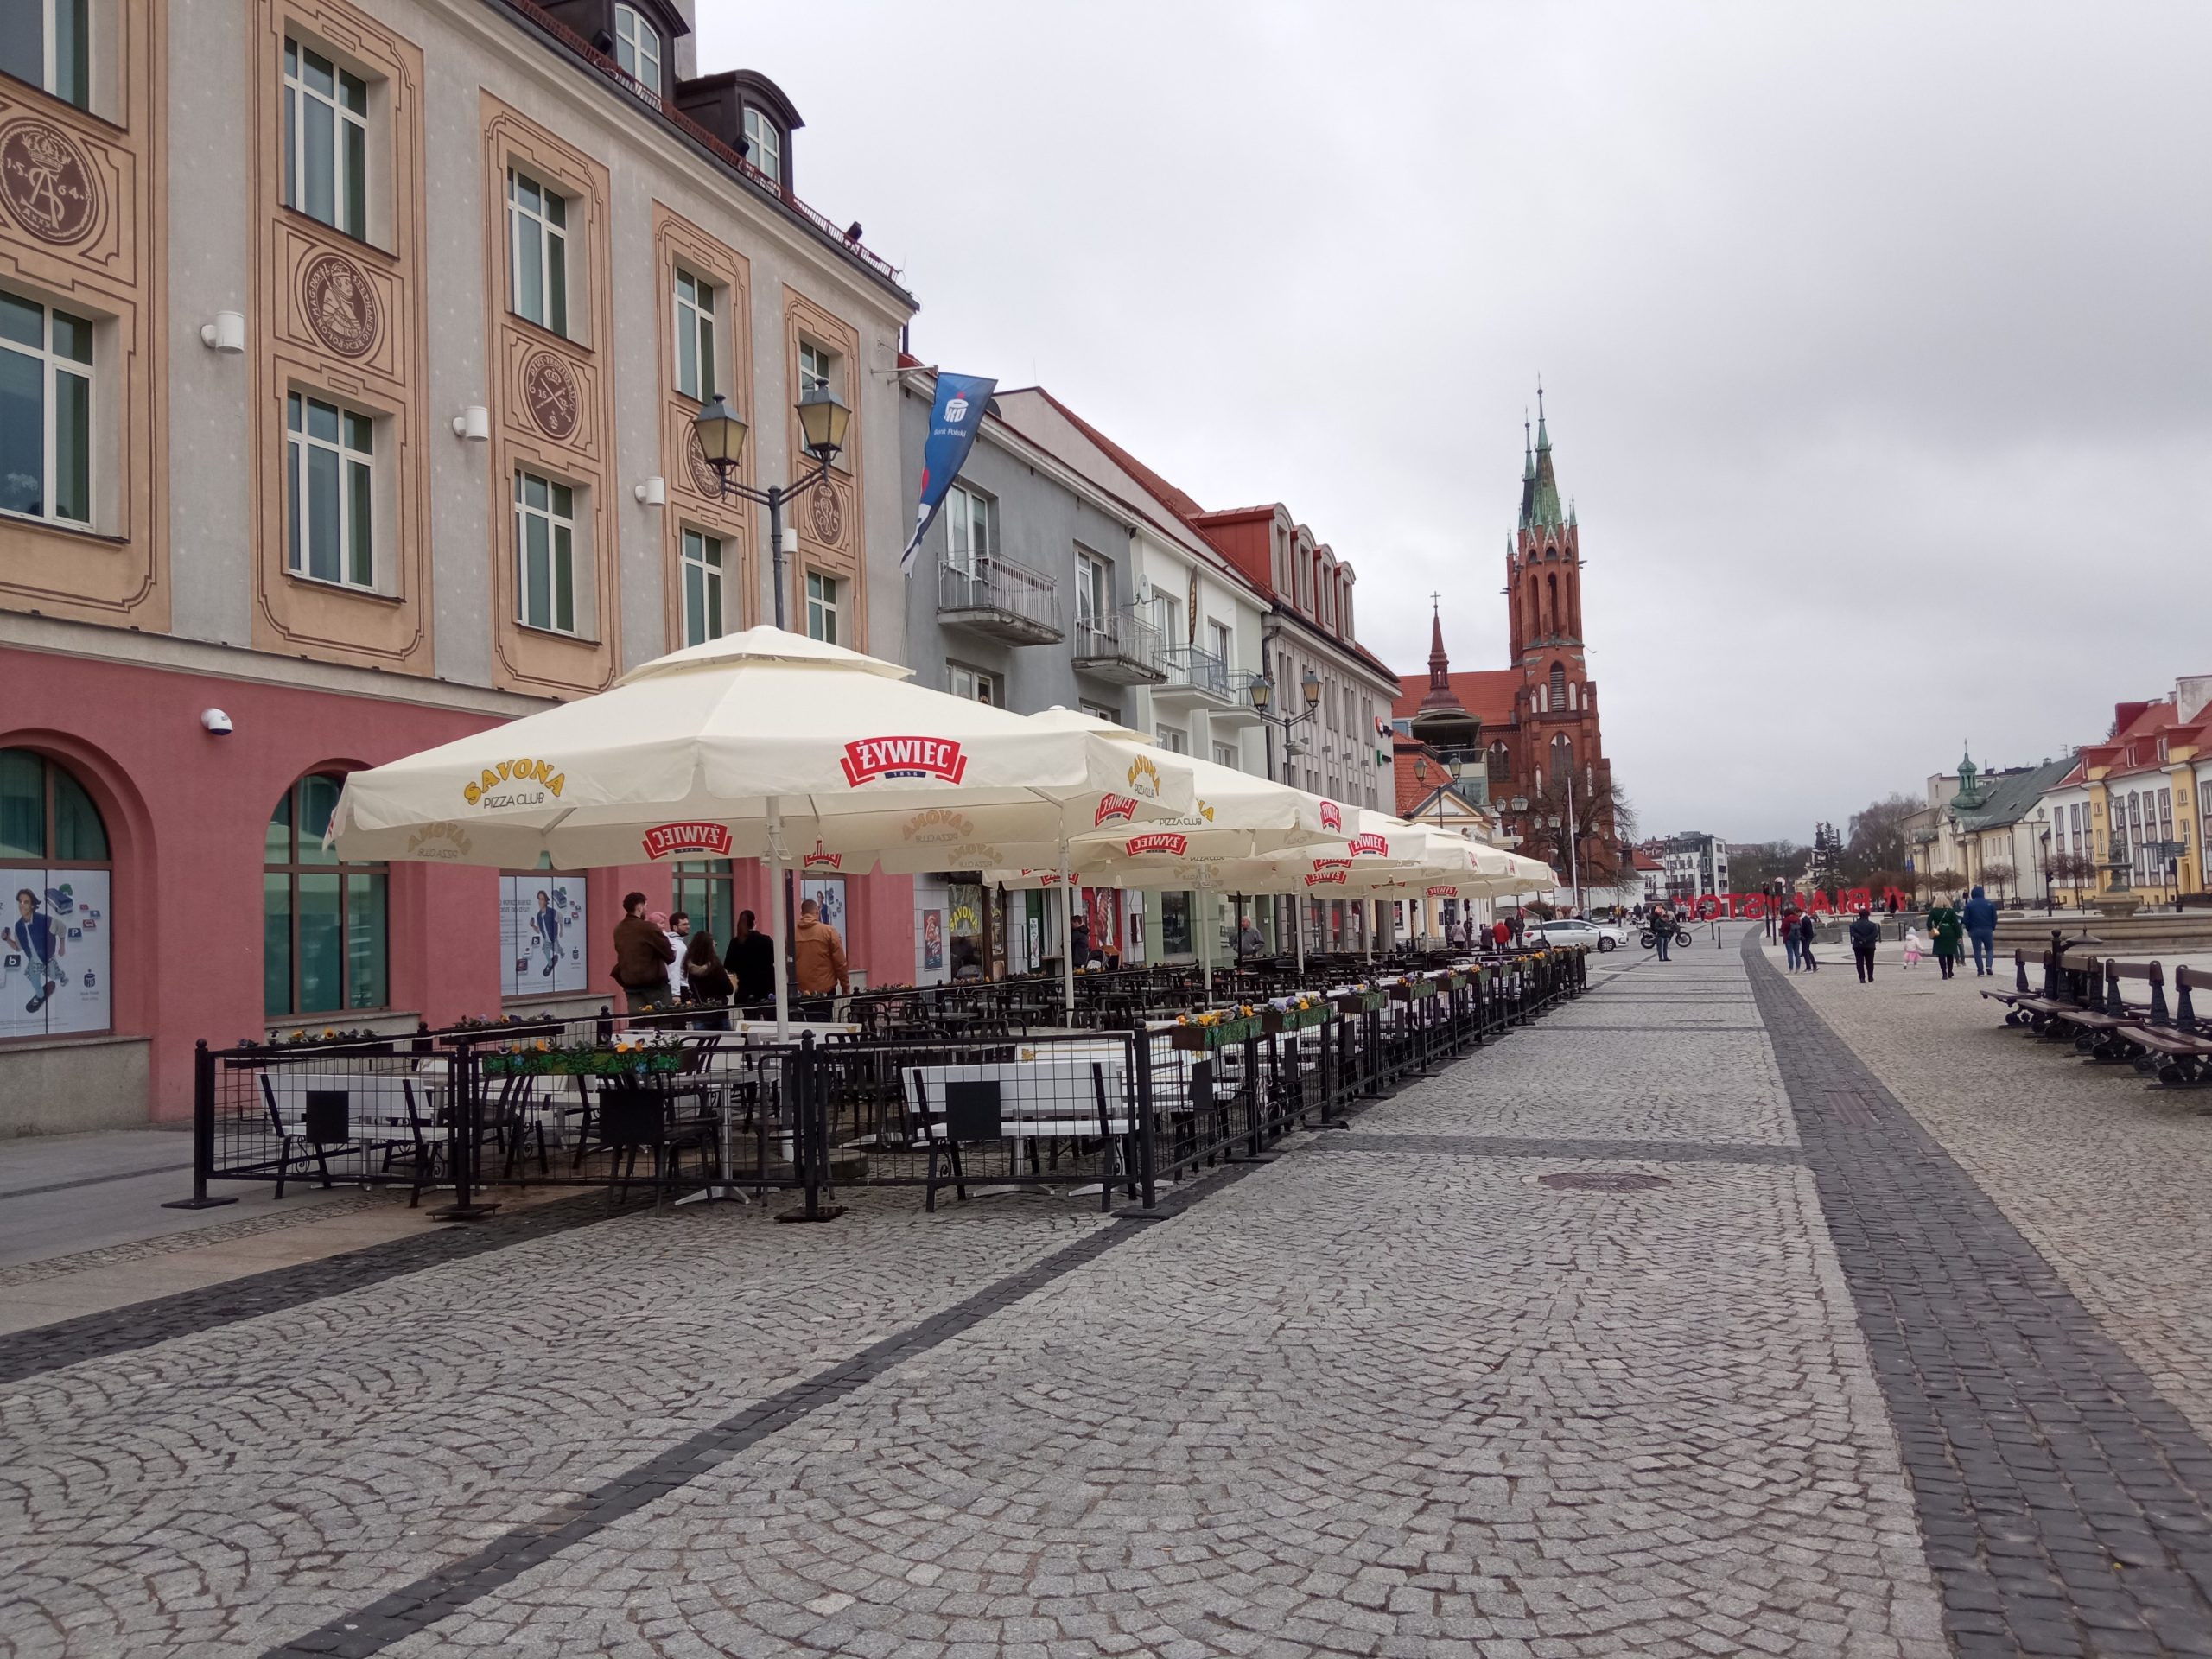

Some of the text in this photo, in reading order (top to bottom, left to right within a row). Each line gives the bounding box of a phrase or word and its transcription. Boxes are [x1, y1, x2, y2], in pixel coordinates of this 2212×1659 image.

[855, 740, 951, 770] ŻYWIEC
[463, 758, 565, 806] SAVONA
[484, 791, 545, 810] PIZZA CLUB
[1159, 817, 1202, 826] PIZZA CLUB
[949, 906, 978, 932] SAVONA
